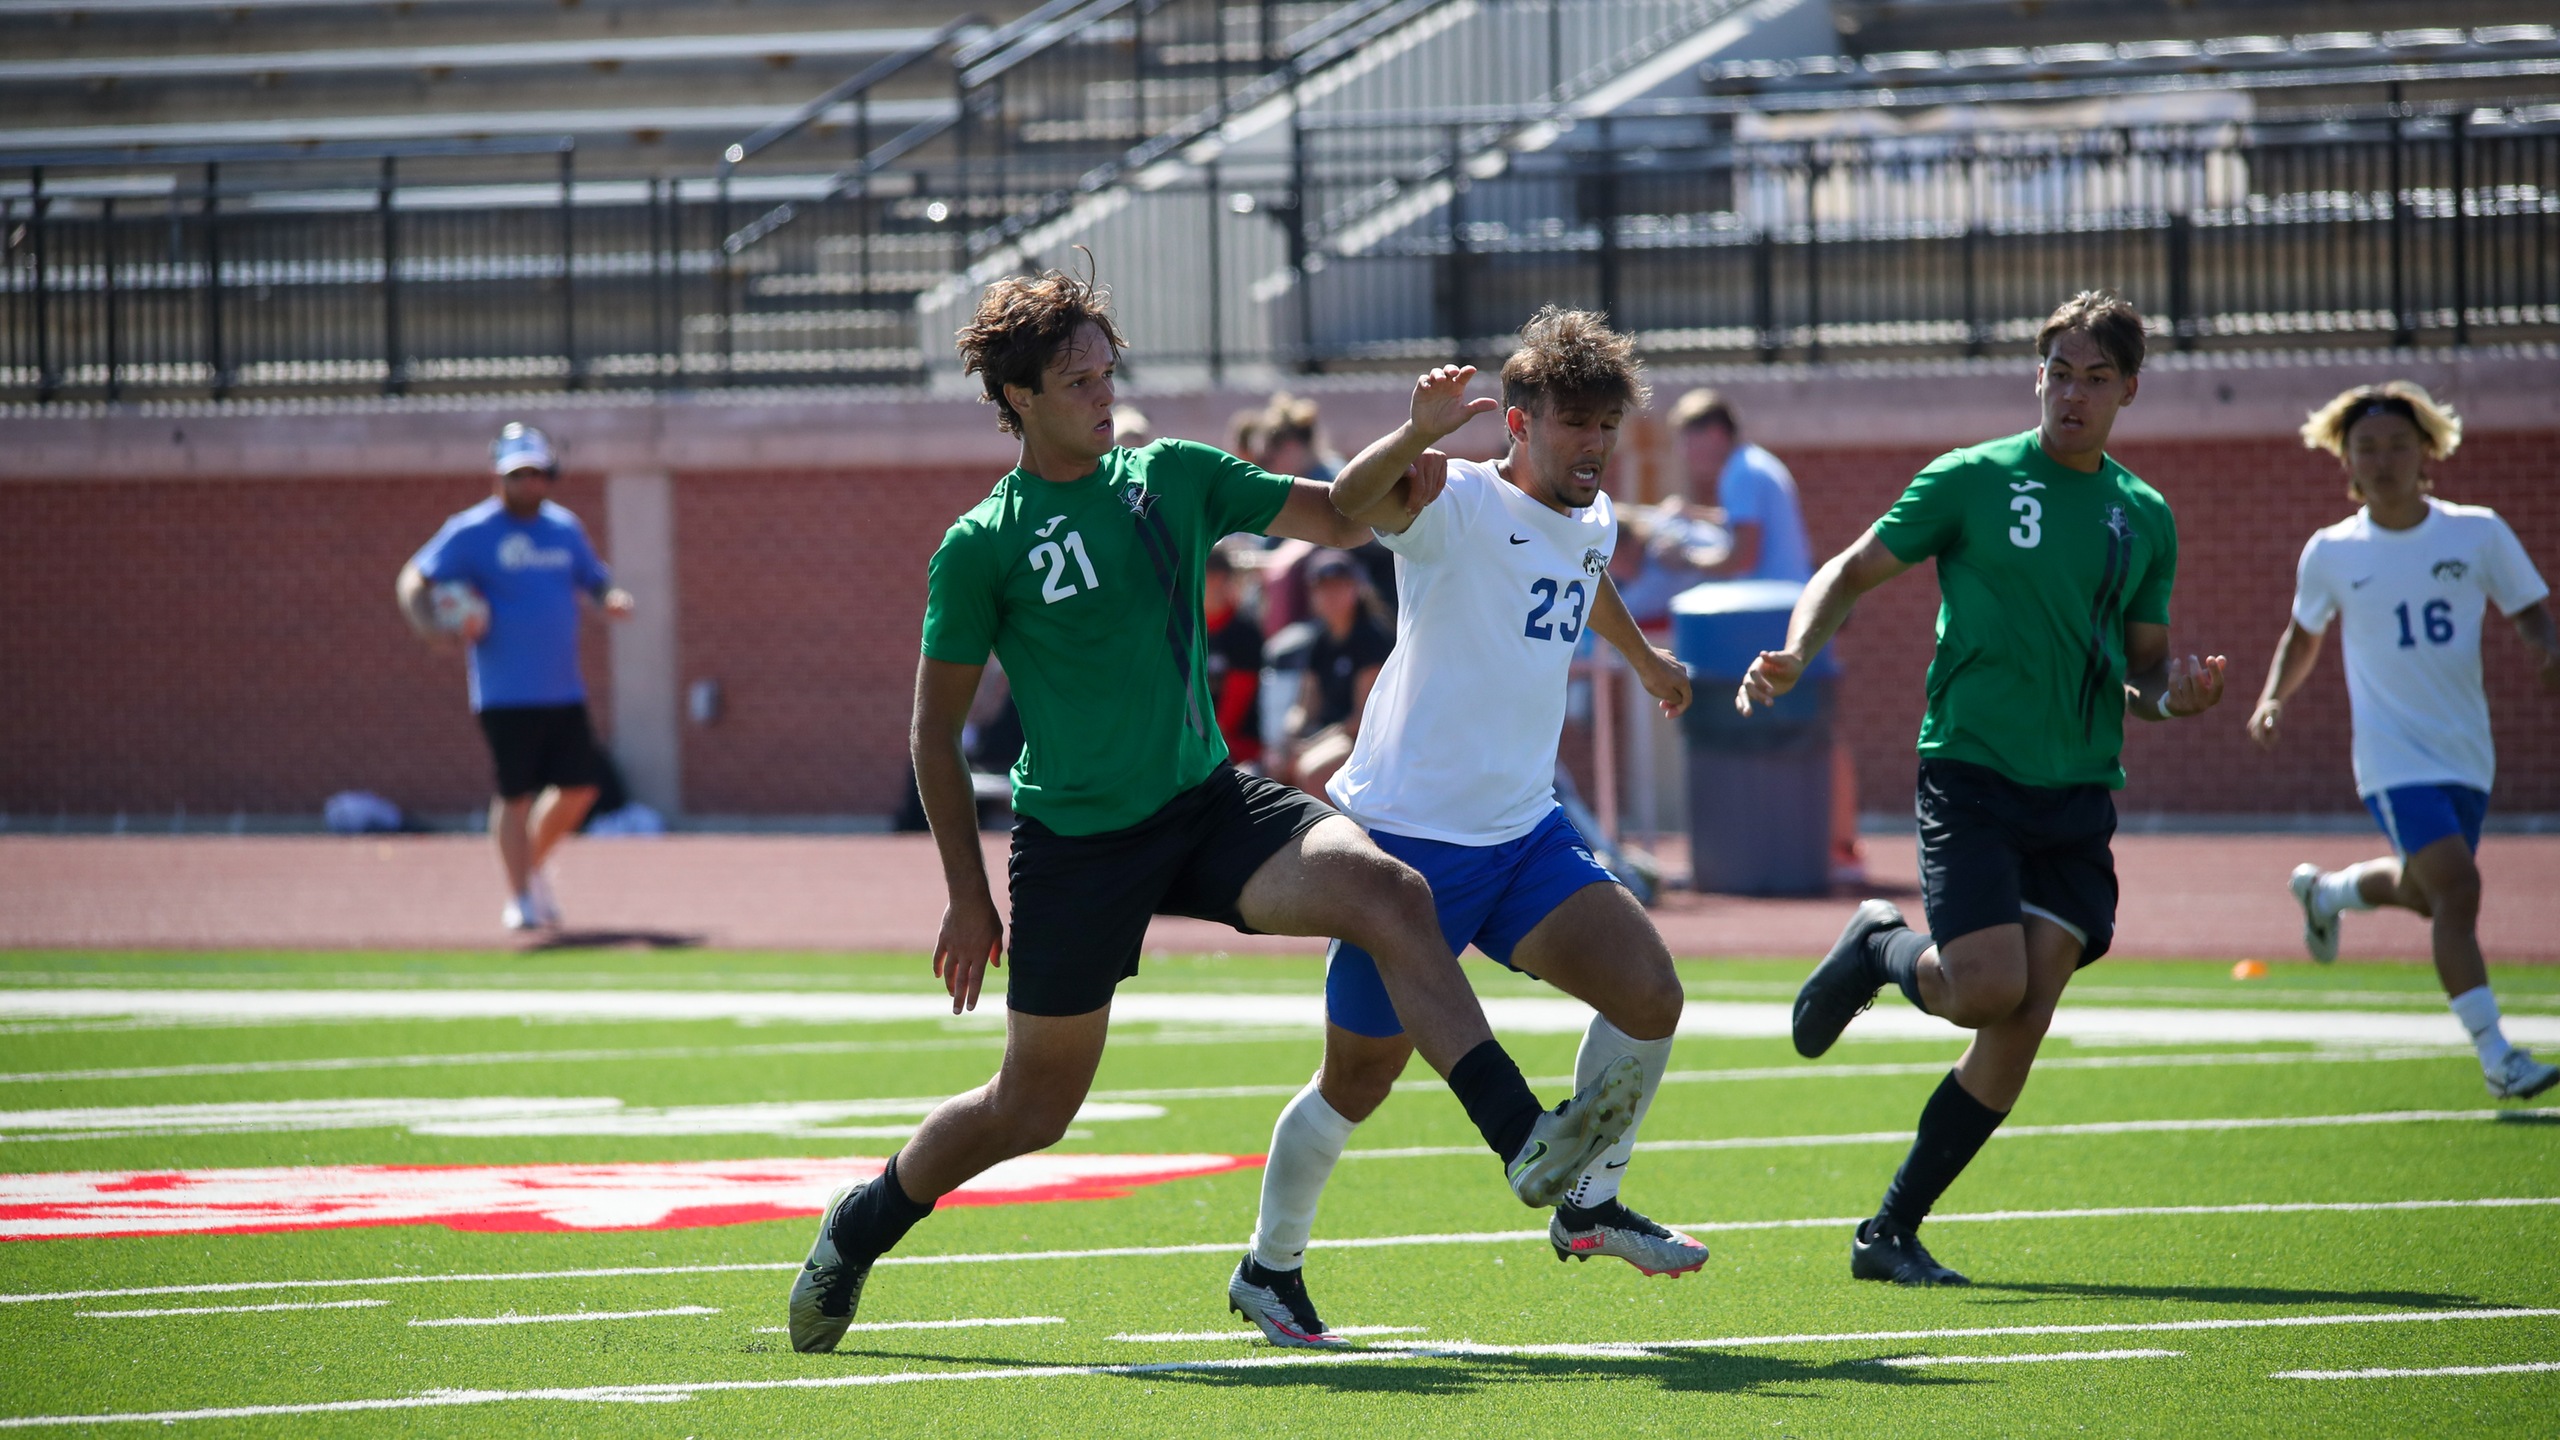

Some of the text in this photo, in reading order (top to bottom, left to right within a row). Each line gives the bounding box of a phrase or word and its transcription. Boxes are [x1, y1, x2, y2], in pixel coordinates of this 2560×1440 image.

[2009, 495, 2042, 548] 3
[1028, 531, 1100, 604] 21
[1524, 578, 1585, 643] 23
[2394, 600, 2454, 646] 16
